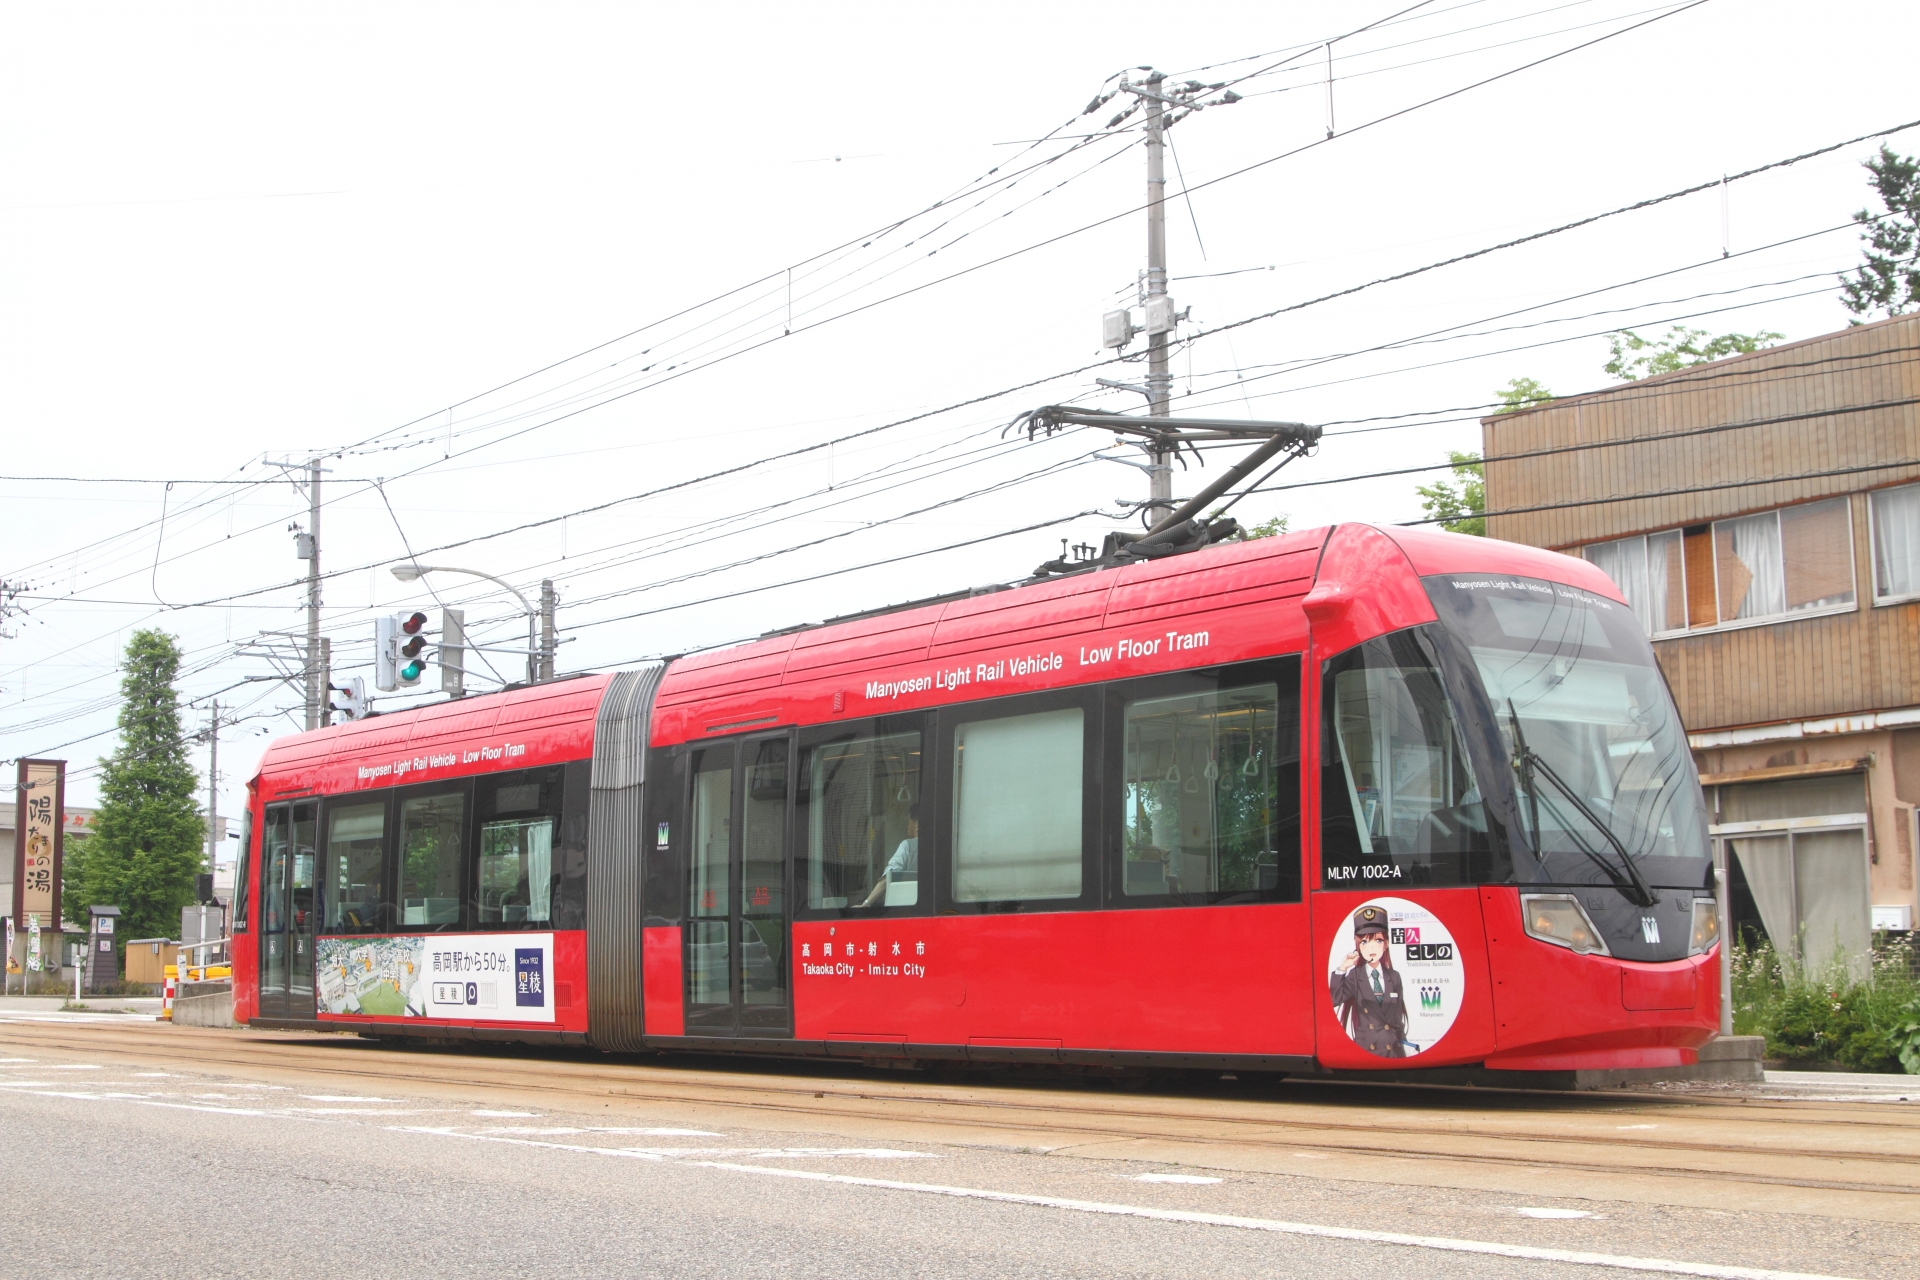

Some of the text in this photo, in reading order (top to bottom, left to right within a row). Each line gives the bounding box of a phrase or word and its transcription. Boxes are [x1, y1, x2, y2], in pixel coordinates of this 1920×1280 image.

[1452, 581, 1612, 610] Manyosen Light Rail Vehicle Low Floor Tram
[866, 630, 1209, 700] Manyosen Light Rail Vehicle Low Floor Tram
[358, 743, 525, 780] Manyosen Light Rail Vehicle Low Floor Tram
[27, 796, 52, 893] 陽だまりの湯
[1328, 865, 1401, 880] MLRV 1002-A
[1392, 928, 1420, 944] 吉久
[356, 947, 368, 960] 大学
[396, 948, 411, 963] 高校
[1407, 944, 1452, 959] こしの
[432, 951, 511, 972] 高岡駅から50分。
[530, 957, 539, 965] 1932
[802, 963, 834, 975] Takaoka
[836, 962, 854, 978] City
[868, 964, 898, 976] Imizu
[904, 962, 926, 978] City
[518, 971, 542, 994] 星稜
